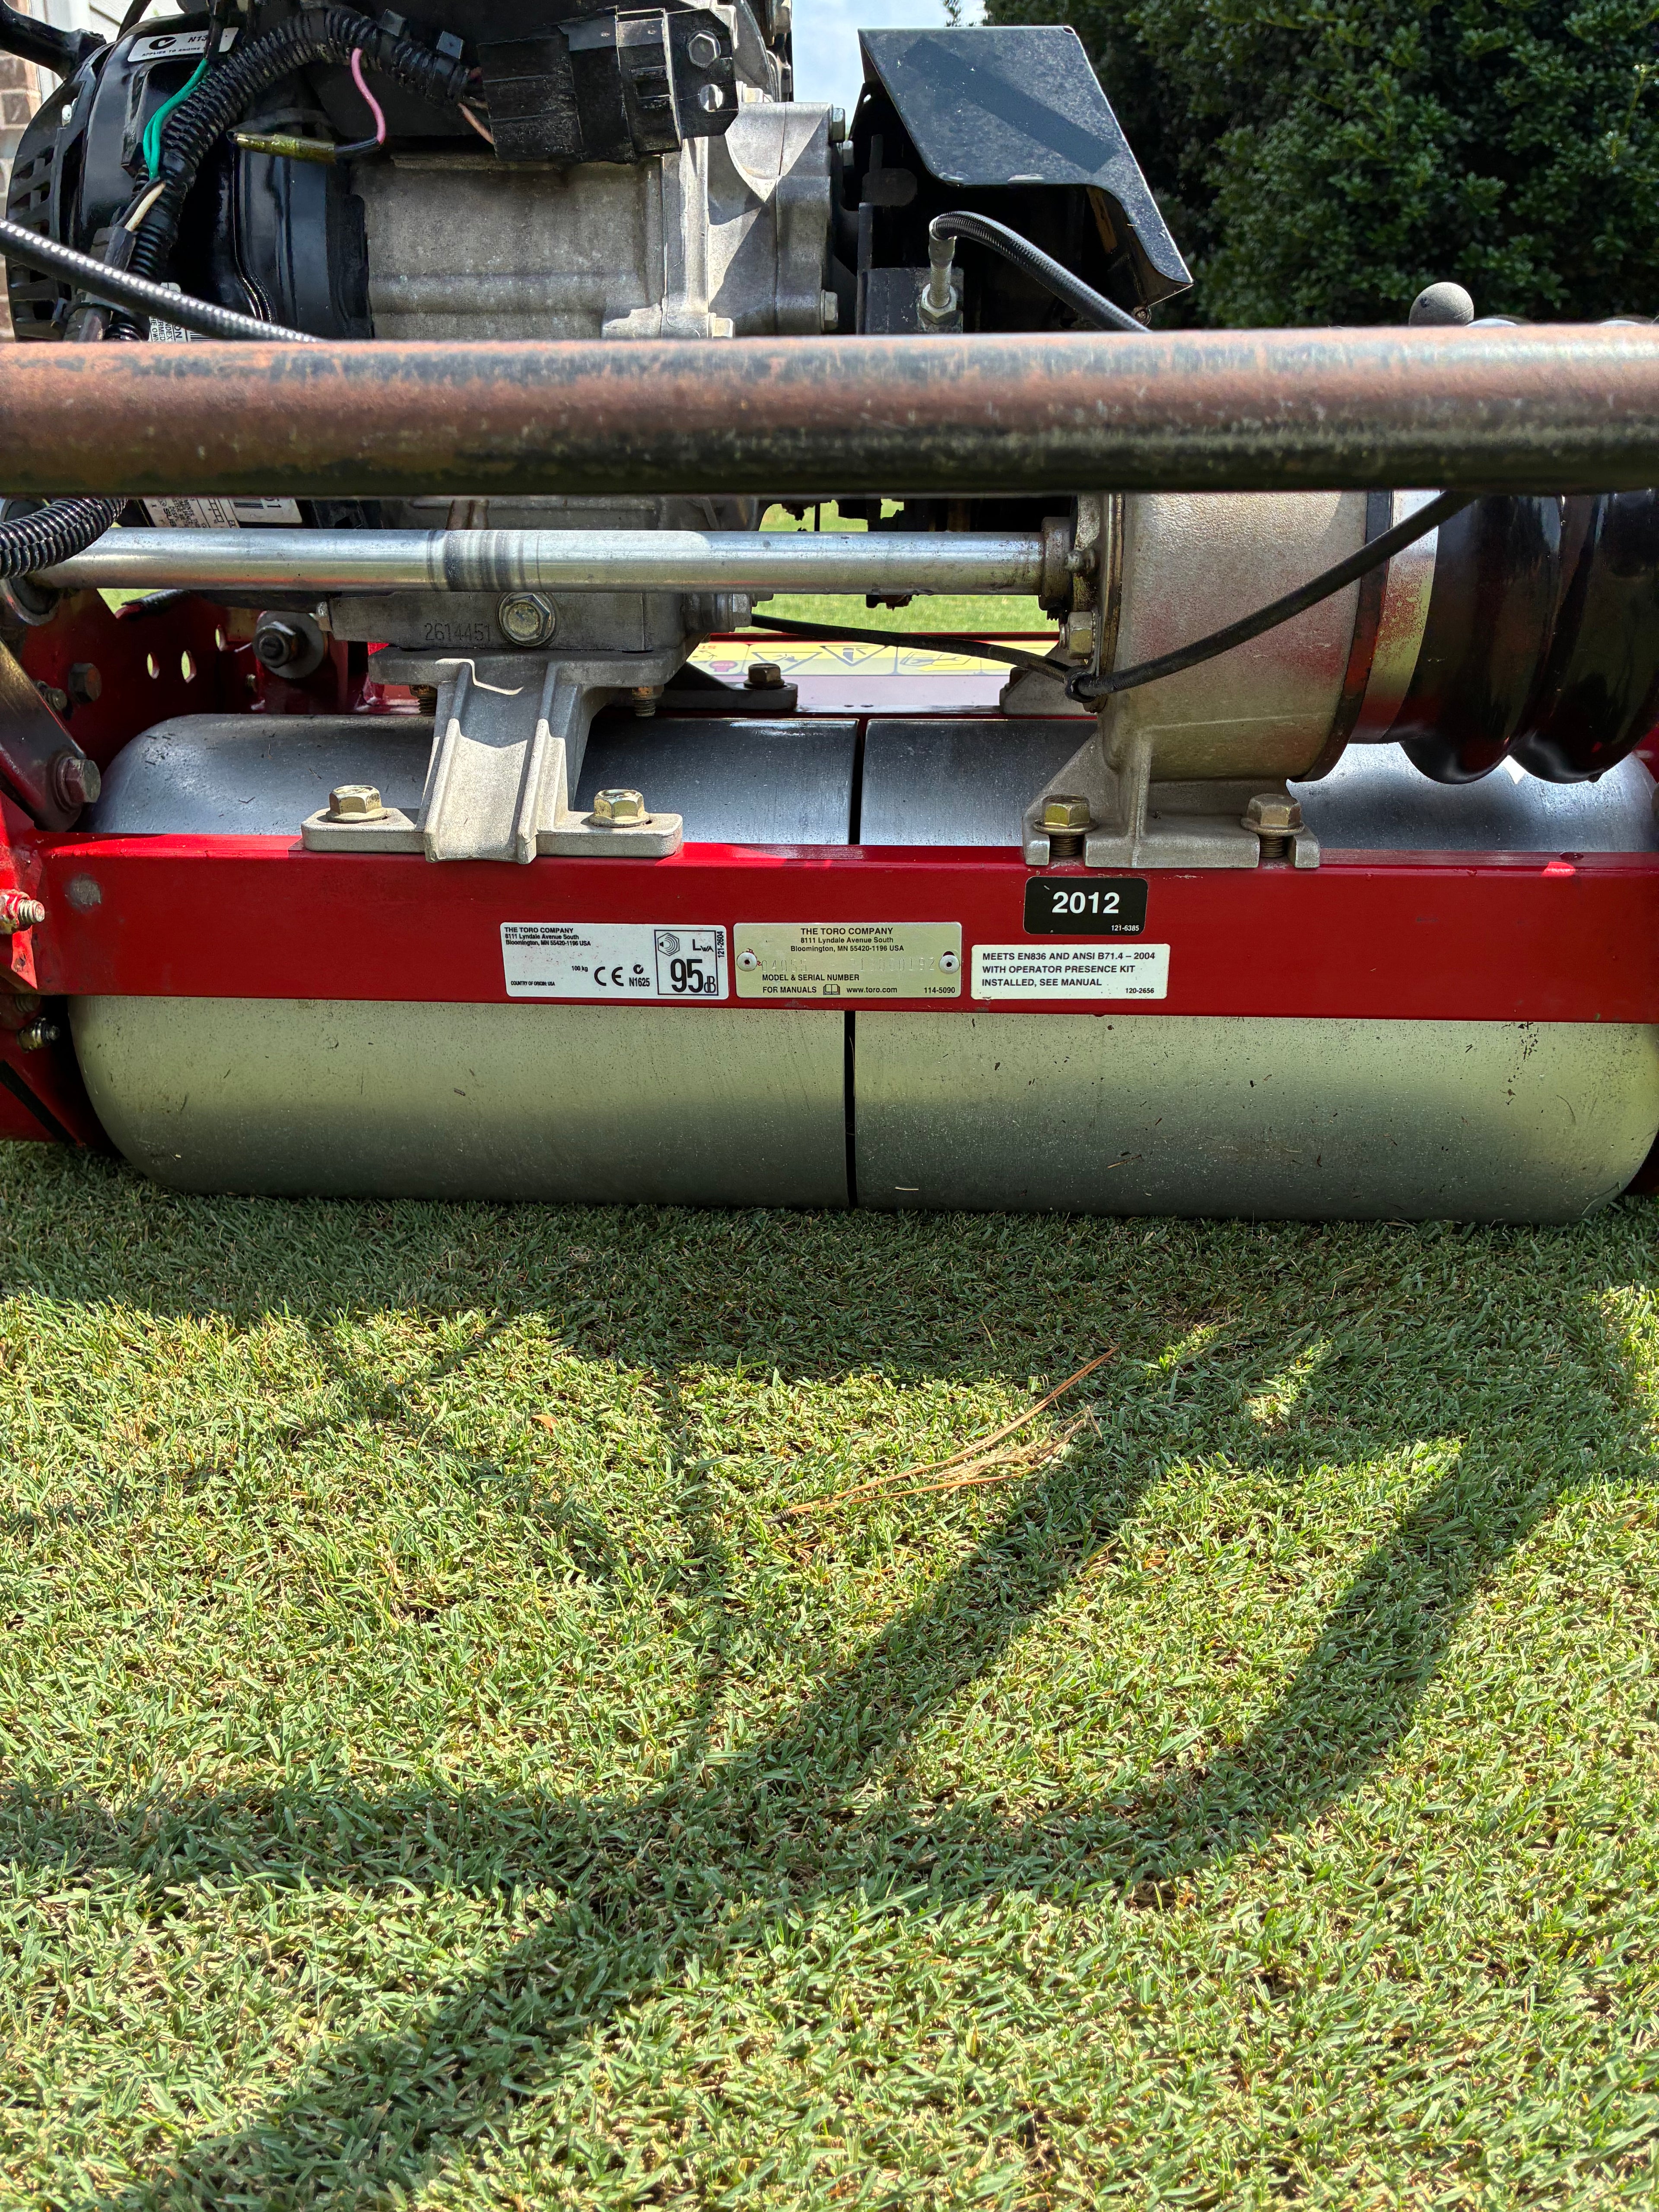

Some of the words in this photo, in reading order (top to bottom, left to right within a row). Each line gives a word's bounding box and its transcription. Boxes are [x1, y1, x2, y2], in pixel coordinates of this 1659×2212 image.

[174, 325, 182, 338] ON
[1052, 891, 1120, 914] 2012
[717, 931, 725, 958] 121-2604
[594, 966, 624, 986] CE
[629, 977, 650, 987] N1625
[982, 979, 1036, 987] INSTALLED,
